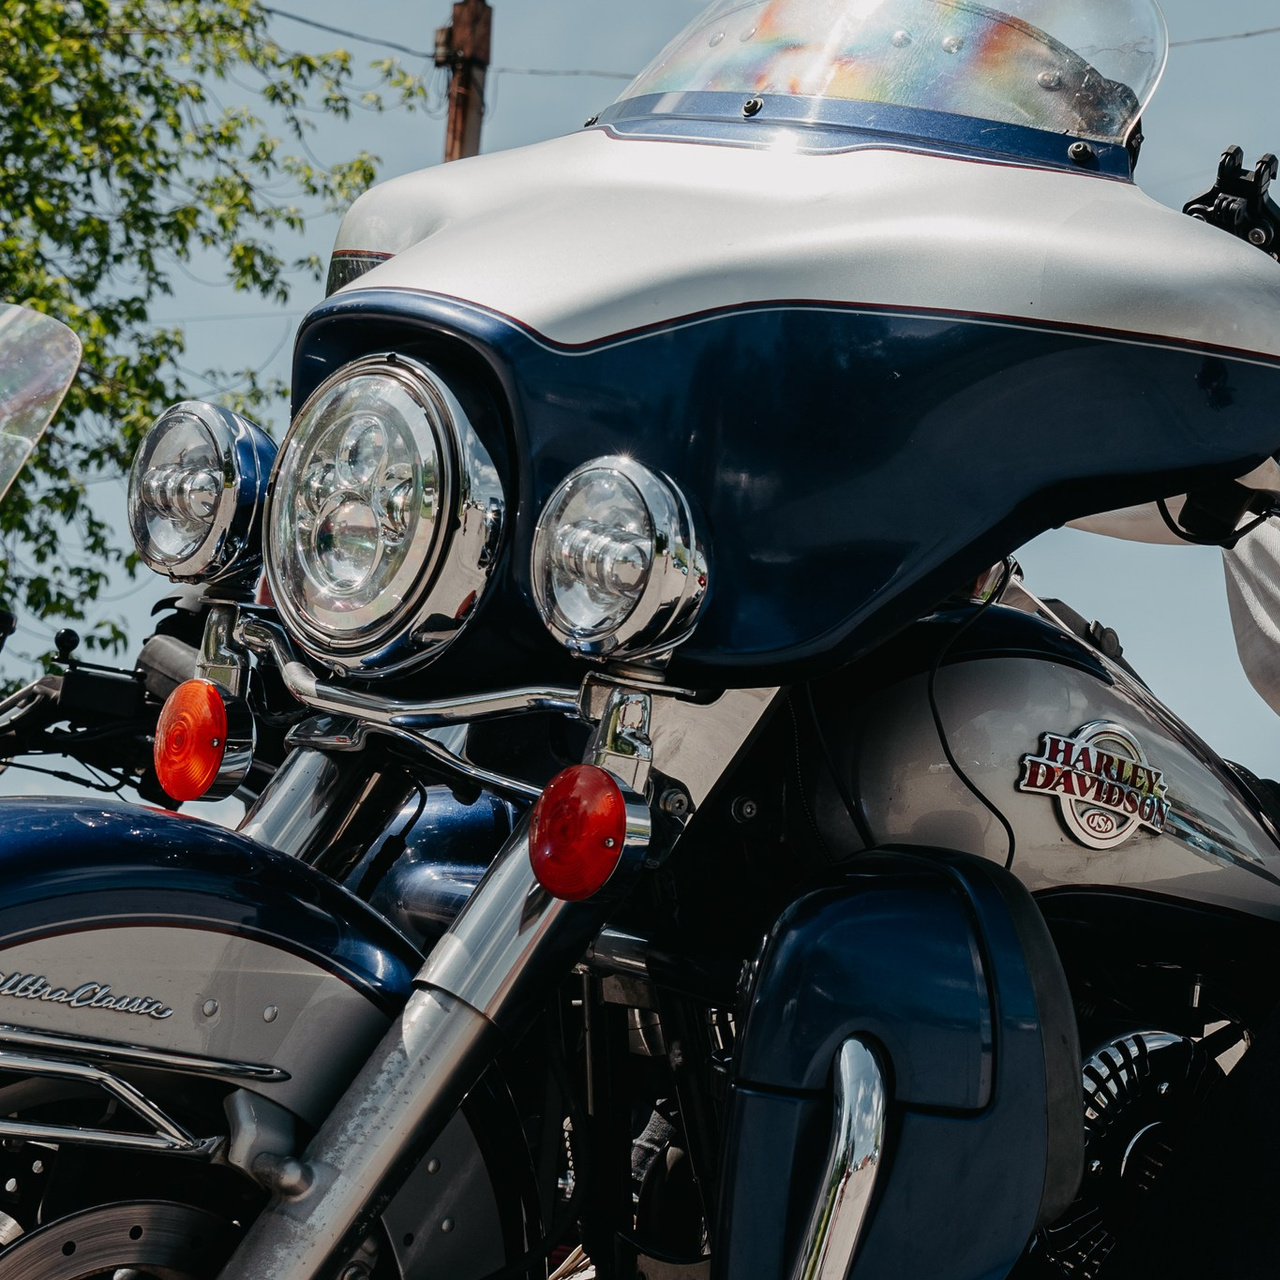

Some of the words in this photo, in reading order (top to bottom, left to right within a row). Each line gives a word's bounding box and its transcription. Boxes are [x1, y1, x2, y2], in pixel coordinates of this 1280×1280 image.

[1045, 736, 1167, 792] HARLEY-
[1024, 759, 1171, 830] DAVIDSON
[1088, 813, 1114, 832] USA
